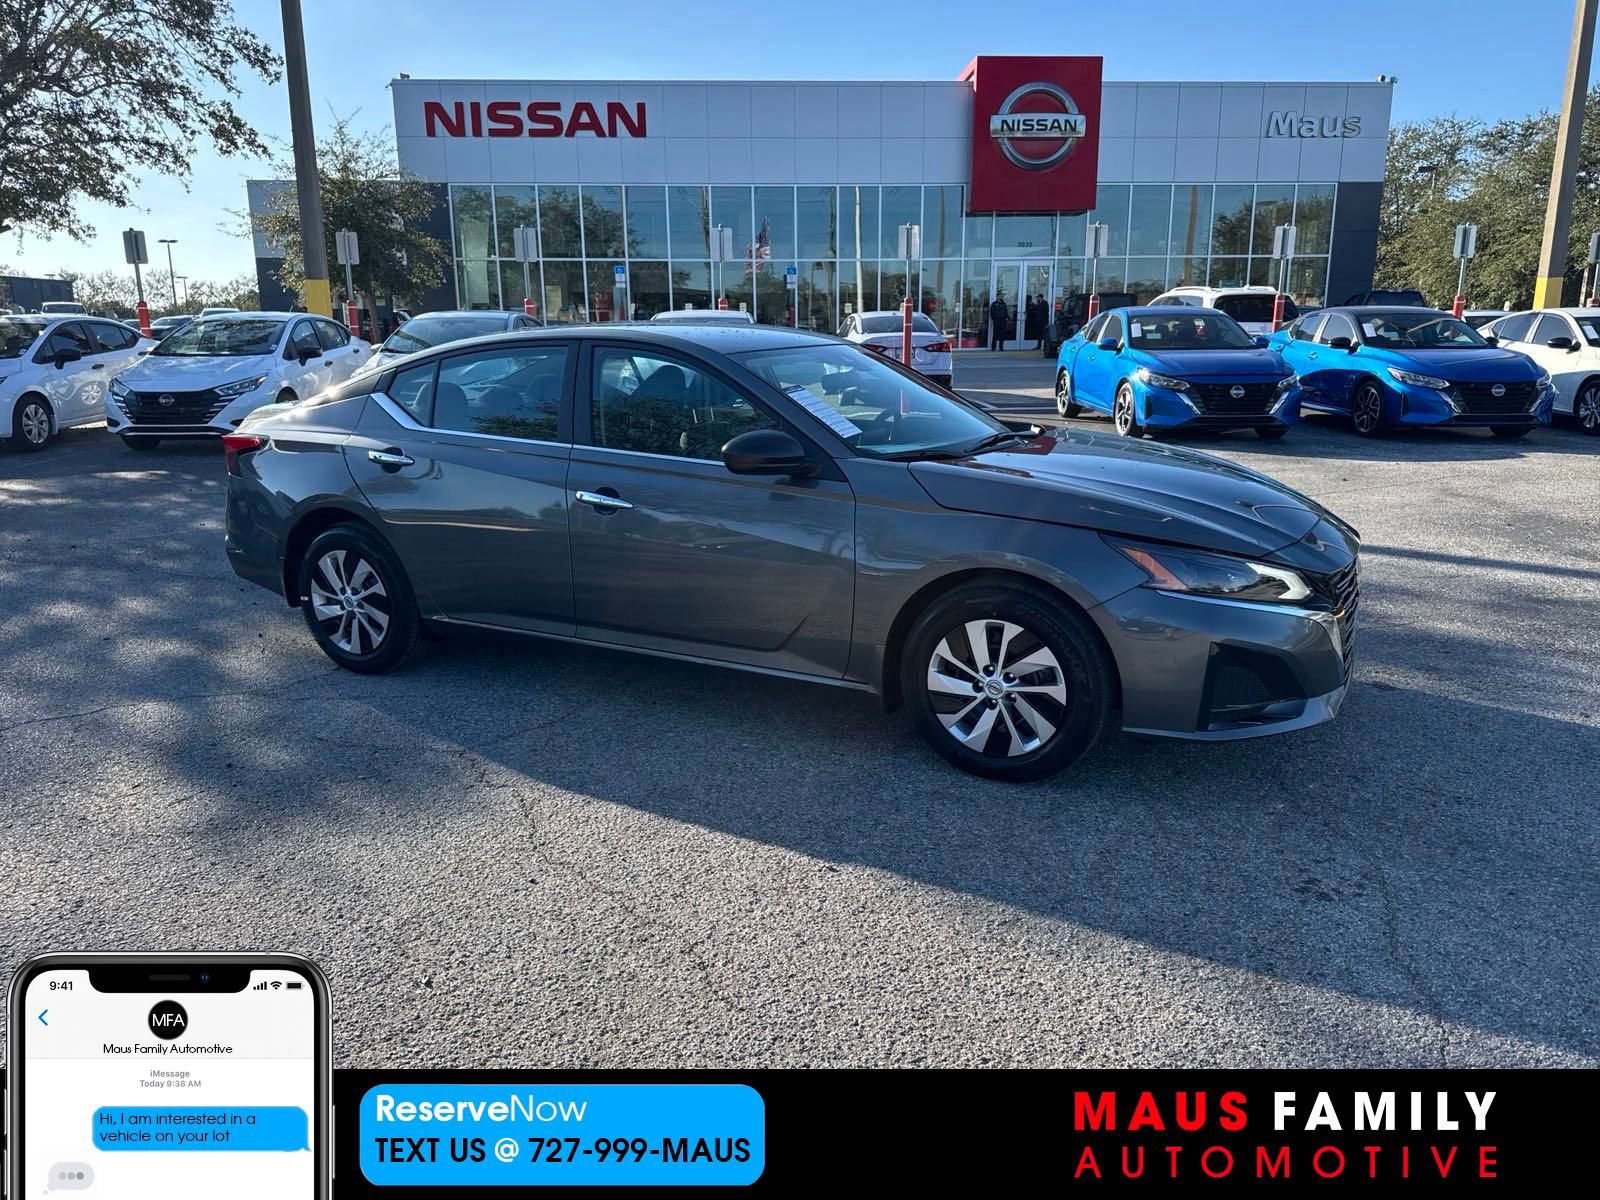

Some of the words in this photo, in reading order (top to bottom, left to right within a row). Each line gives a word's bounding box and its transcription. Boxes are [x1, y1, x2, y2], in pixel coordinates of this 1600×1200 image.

[424, 101, 647, 138] NISSAN
[1000, 119, 1077, 132] NISSAN
[1266, 110, 1361, 138] Maus
